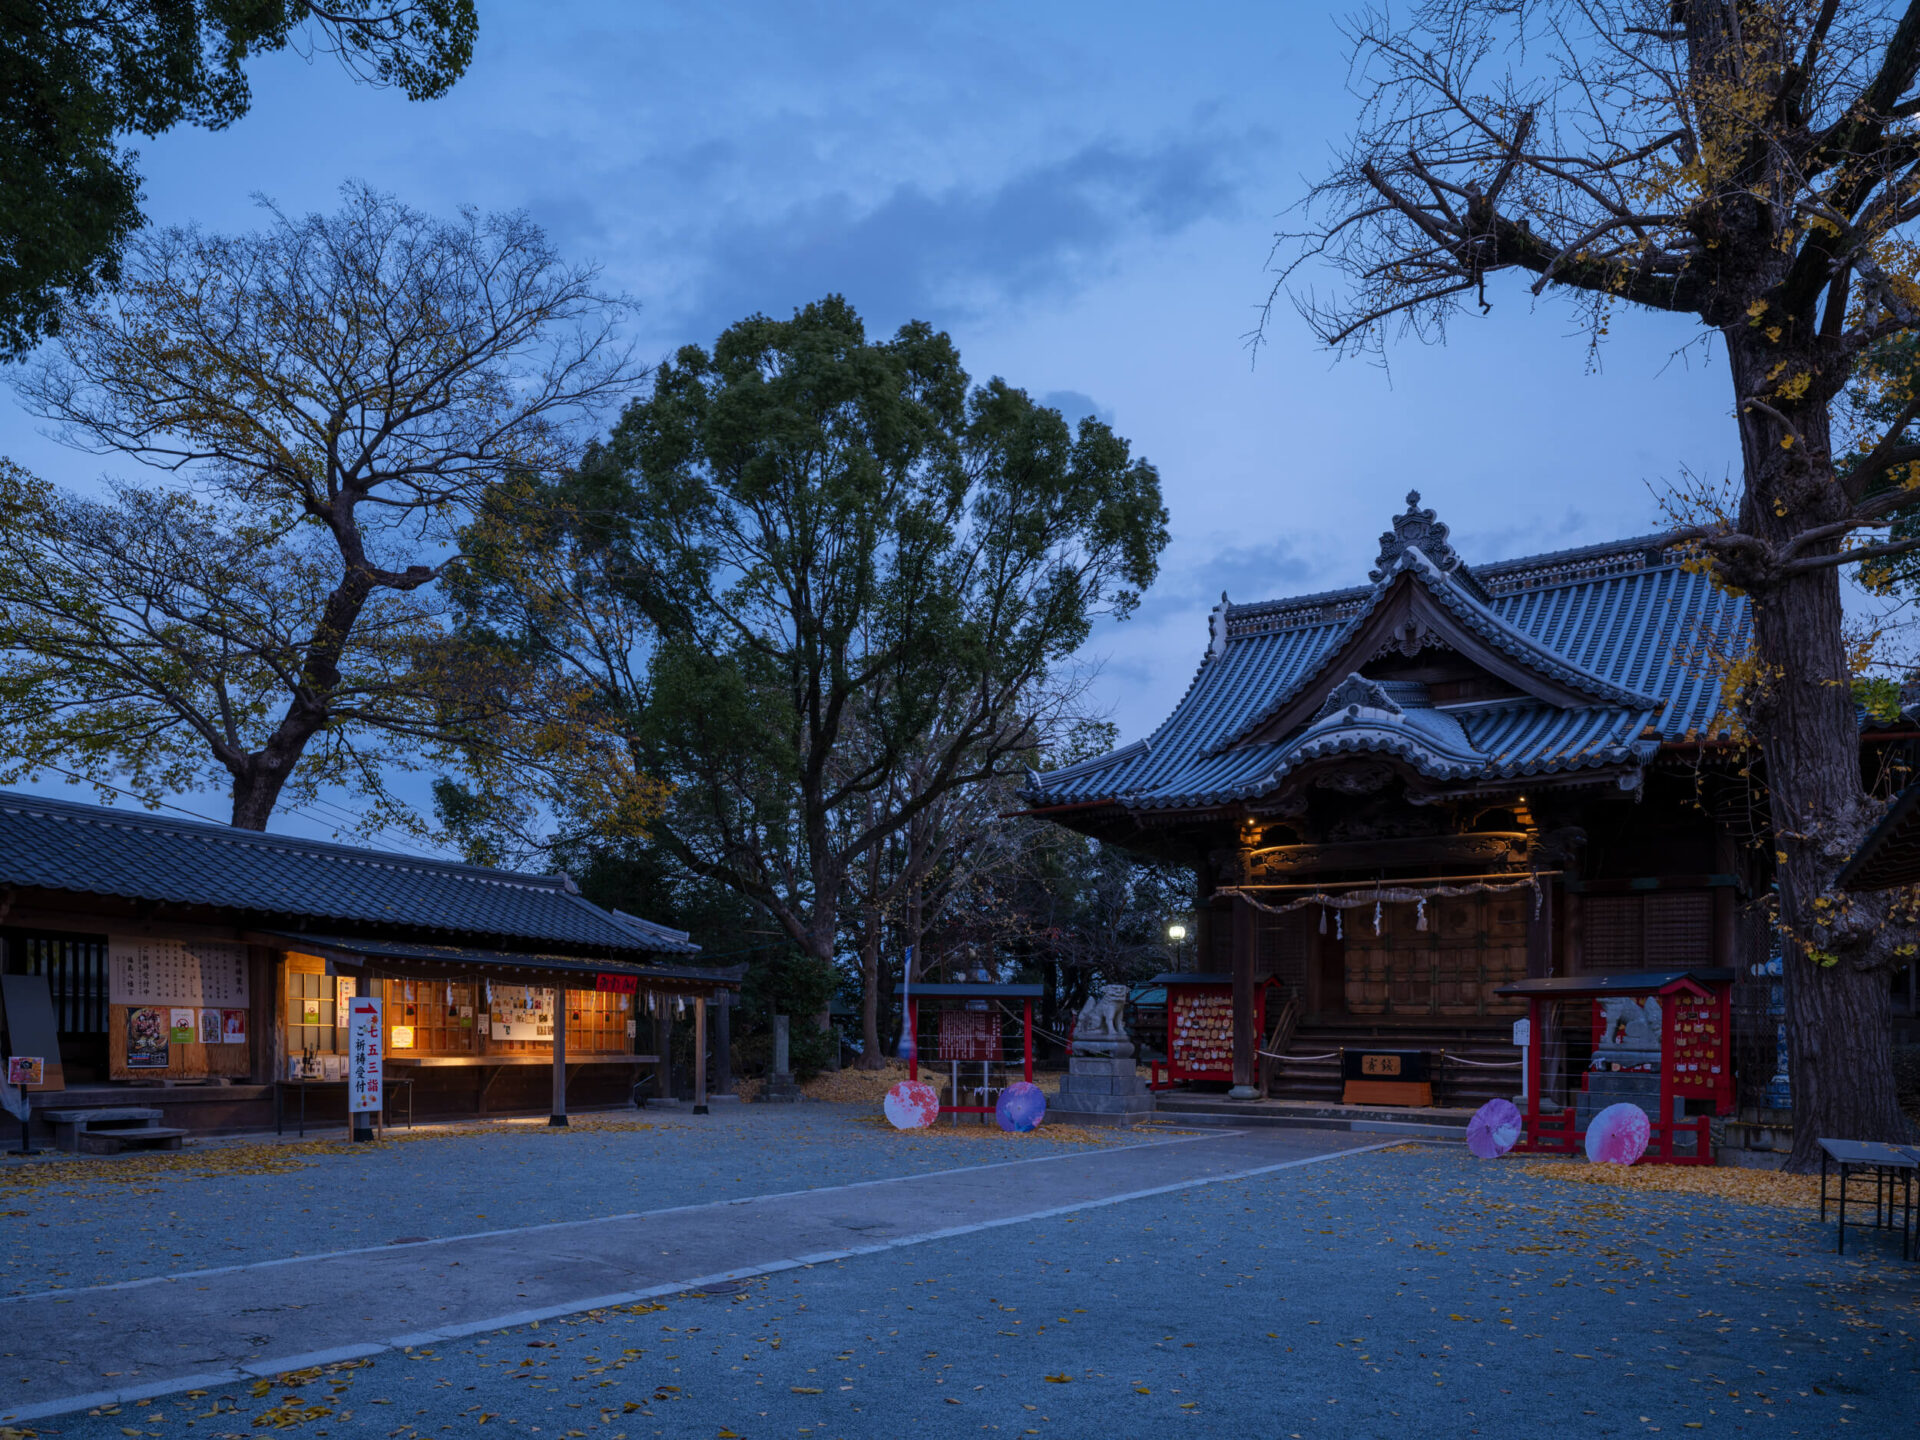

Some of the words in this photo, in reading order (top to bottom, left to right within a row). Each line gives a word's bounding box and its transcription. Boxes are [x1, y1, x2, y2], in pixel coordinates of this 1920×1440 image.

[355, 1024, 366, 1093] ご祈祷受付
[367, 1024, 379, 1092] 七五三詣
